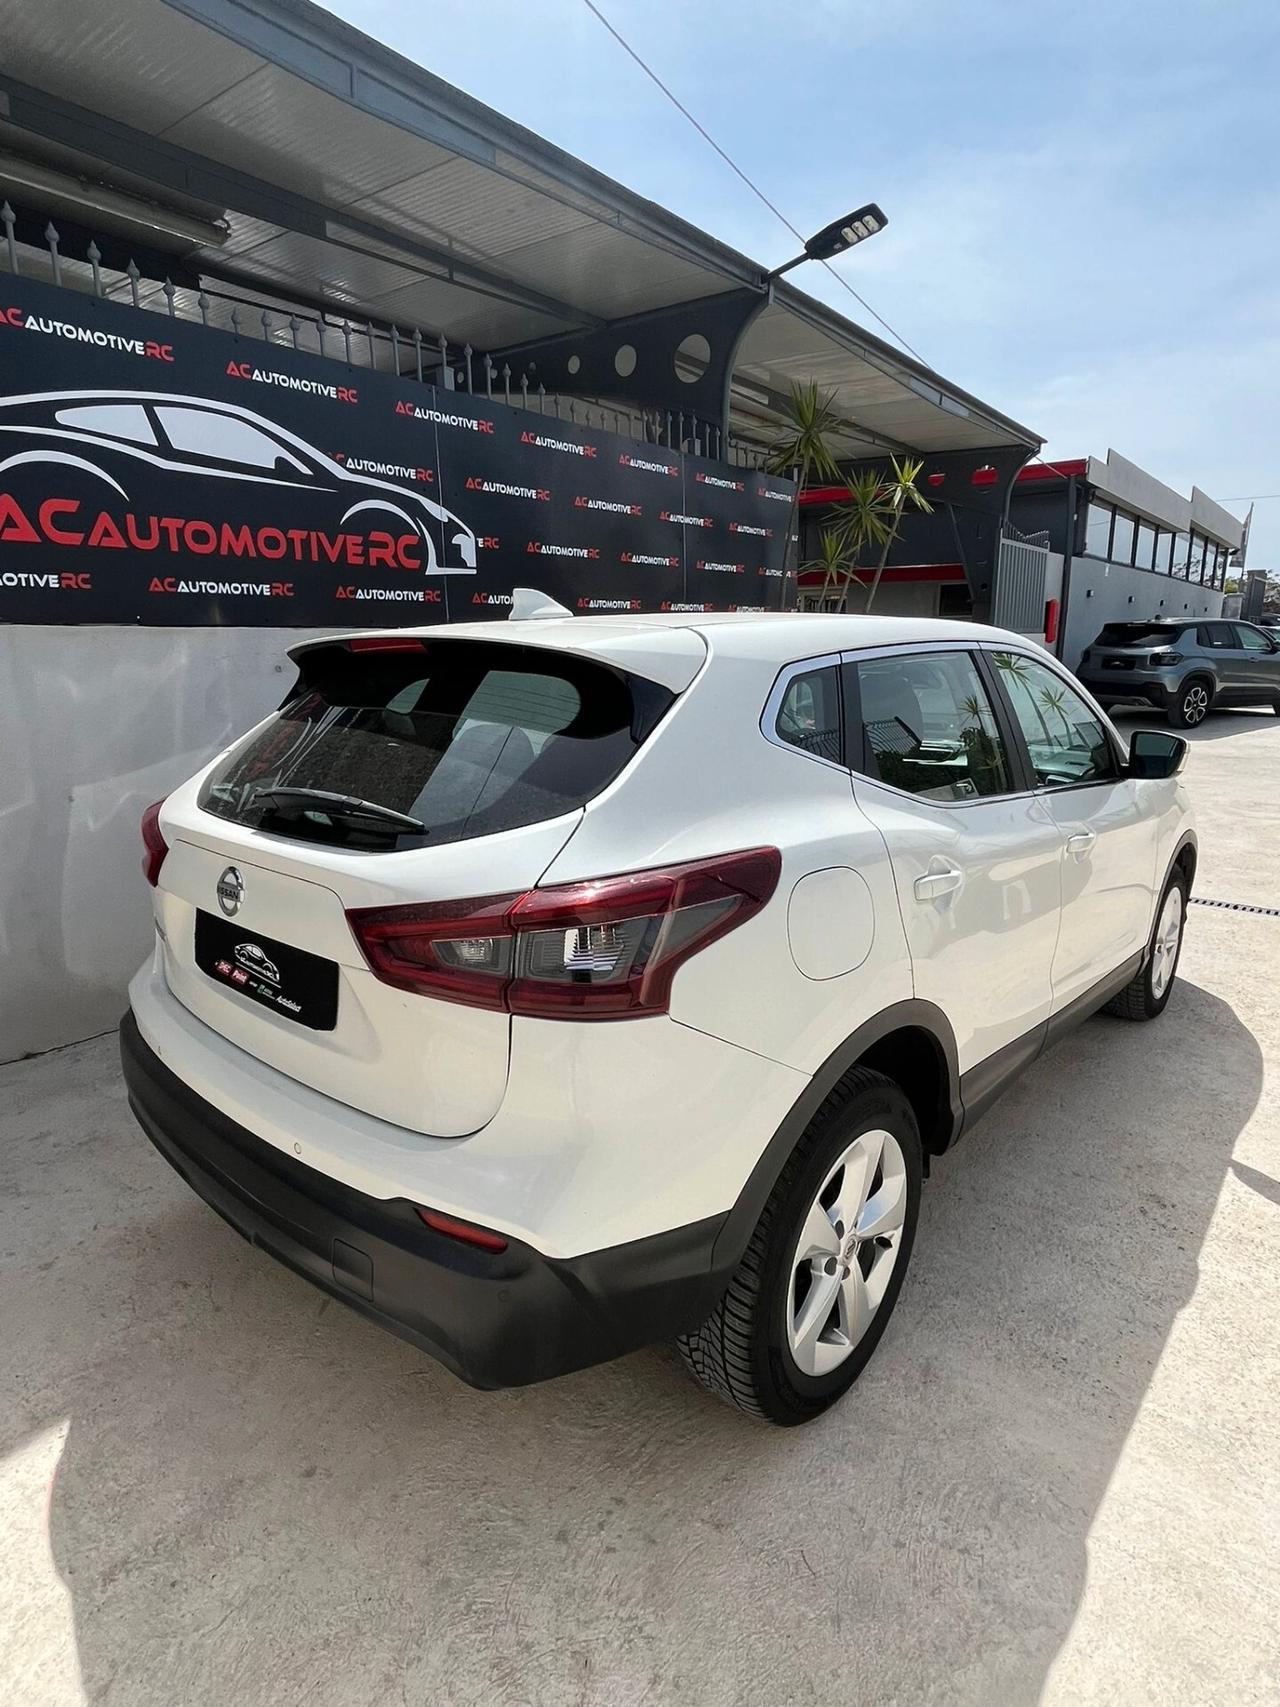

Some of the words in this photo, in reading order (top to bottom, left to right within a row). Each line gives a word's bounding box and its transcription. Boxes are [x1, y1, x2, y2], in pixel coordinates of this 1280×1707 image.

[226, 360, 358, 404] ACAUTOMOTIVERC
[395, 400, 494, 434] ACAUTOMOTIVERC
[520, 431, 597, 457] ACAUTOMOTIVERC
[619, 454, 679, 477] ACAUTOMOTIVERC
[465, 477, 550, 501] ACAUTOMOTIVERC
[696, 473, 745, 492] ACAUTOMOTIVERC
[574, 496, 642, 516] ACAUTOMOTIVERC
[659, 511, 713, 528] ACAUTOMOTIVERC
[0, 492, 421, 570] ACAUTOMOTIVERC
[527, 542, 600, 559] ACAUTOMOTIVERC
[620, 552, 679, 567] ACAUTOMOTIVERC
[696, 560, 744, 574] ACAUTOMOTIVERC
[149, 577, 295, 597] ACAUTOMOTIVERC
[335, 586, 441, 602] ACAUTOMOTIVERC
[576, 597, 641, 610] ACAUTOMOTIVERC
